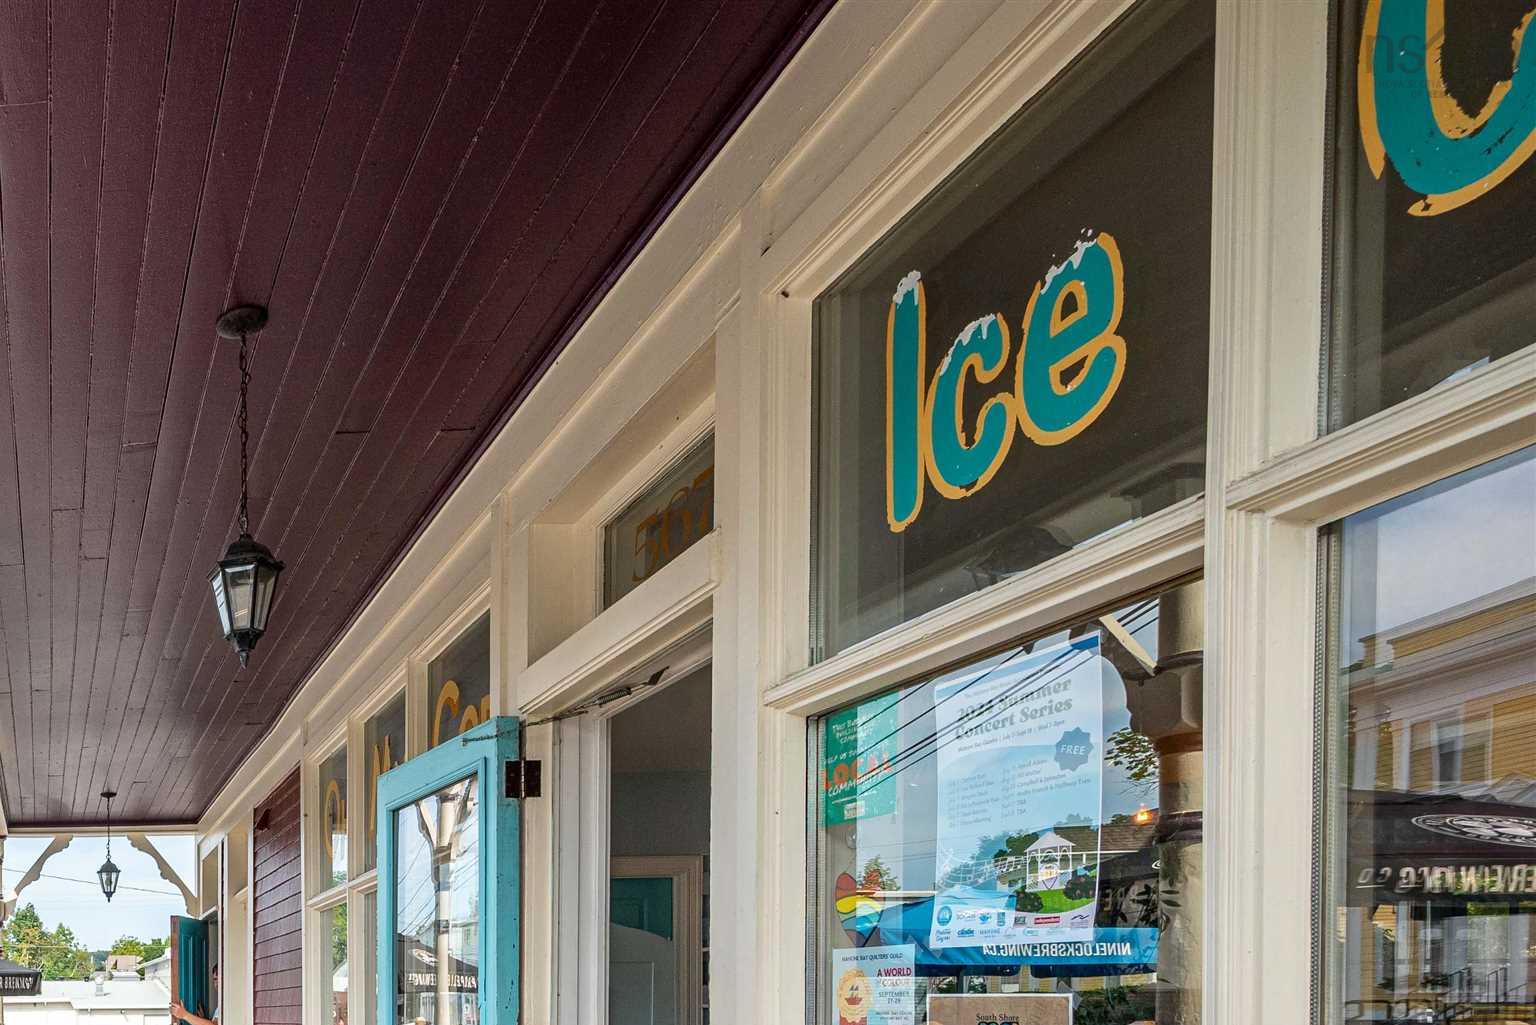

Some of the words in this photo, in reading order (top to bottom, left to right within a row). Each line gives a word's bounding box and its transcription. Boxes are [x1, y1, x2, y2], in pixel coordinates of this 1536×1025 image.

[886, 229, 1126, 533] Ice
[1019, 698, 1073, 722] Series
[1060, 744, 1086, 755] FREE
[877, 968, 883, 977] A
[884, 967, 912, 977] WORLD
[975, 1013, 997, 1021] South
[998, 1013, 1020, 1021] Shore
